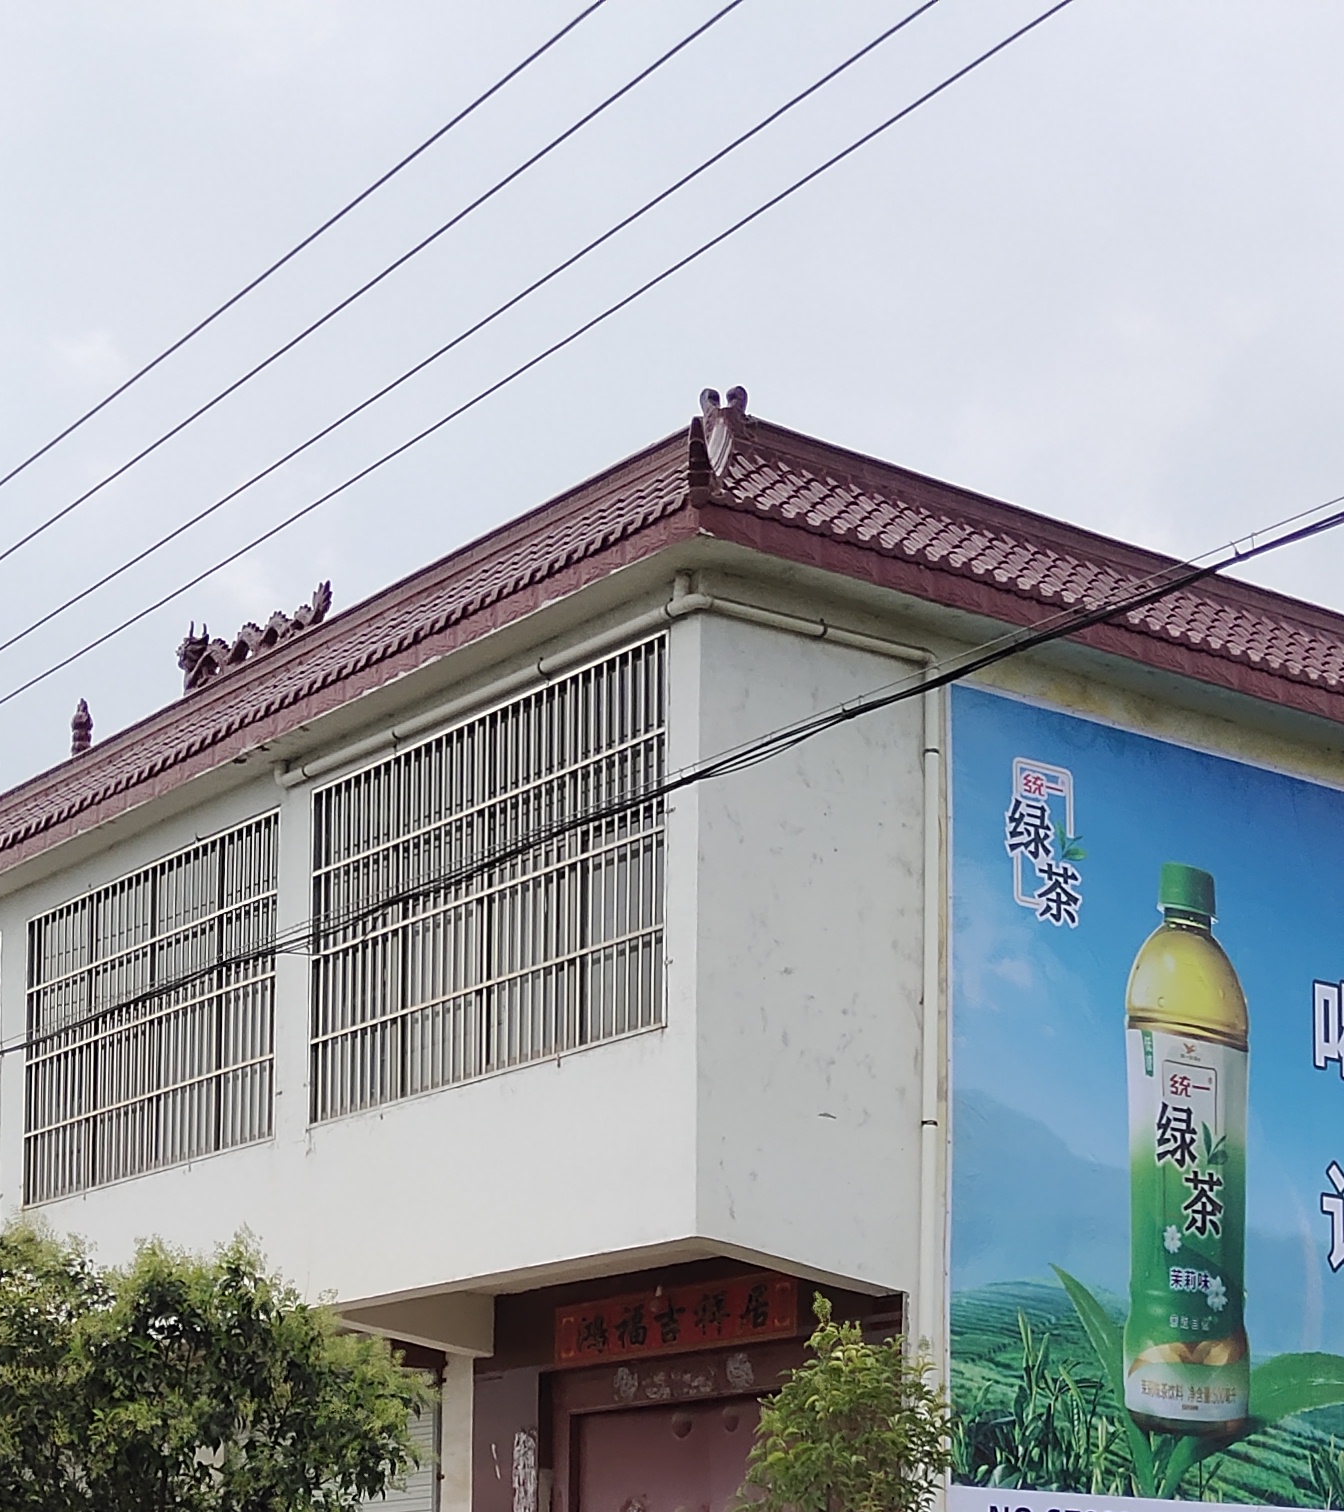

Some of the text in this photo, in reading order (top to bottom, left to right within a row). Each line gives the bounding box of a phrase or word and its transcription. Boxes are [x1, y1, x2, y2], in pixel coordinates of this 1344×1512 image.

[1023, 773, 1064, 797] 统一
[1007, 797, 1081, 926] 绿茶
[1169, 1073, 1211, 1098] 统一
[1156, 1101, 1224, 1236] 绿茶
[1170, 1267, 1210, 1292] 茉莉味
